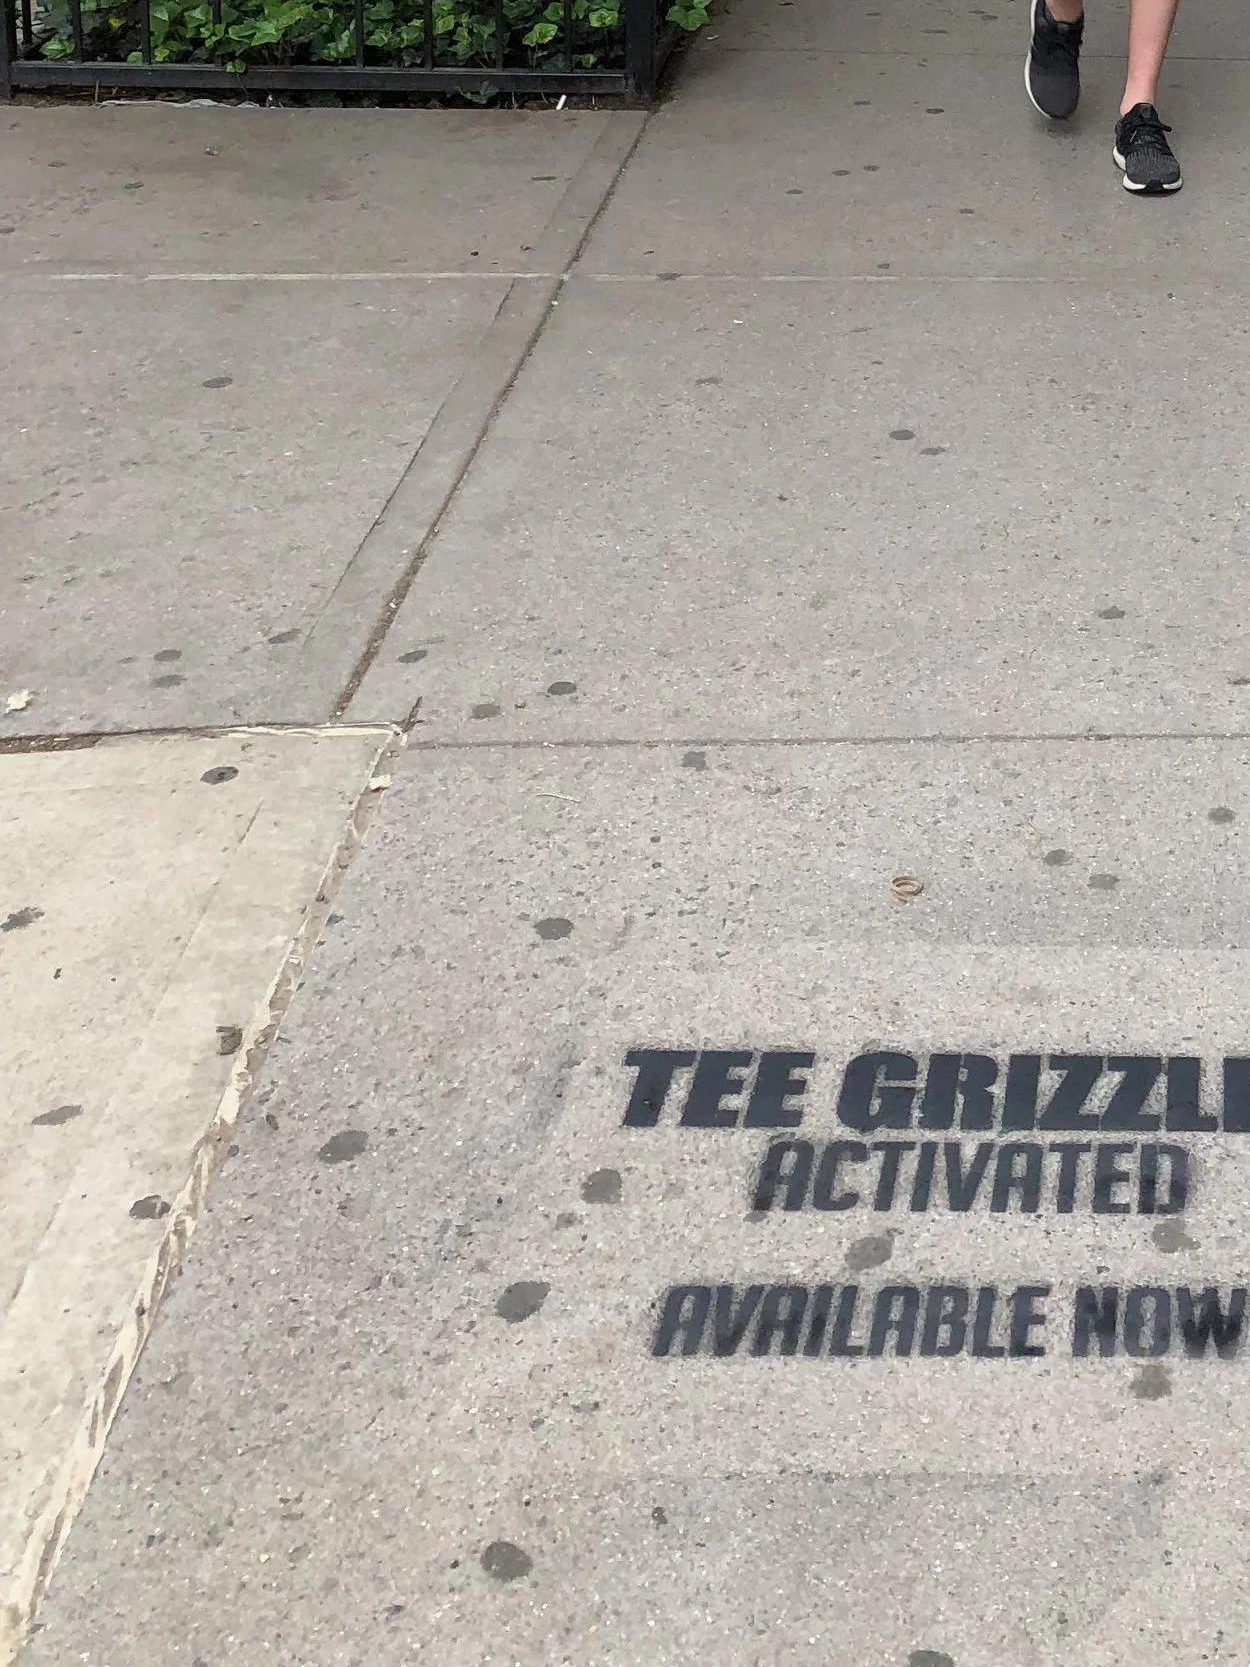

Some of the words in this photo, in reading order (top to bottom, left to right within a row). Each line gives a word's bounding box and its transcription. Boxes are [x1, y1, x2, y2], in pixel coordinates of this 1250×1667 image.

[622, 1049, 815, 1128] TEE
[751, 1139, 1192, 1215] ACTIVATED
[651, 1284, 1051, 1357] AVAILABLE
[1071, 1285, 1250, 1360] NOW
